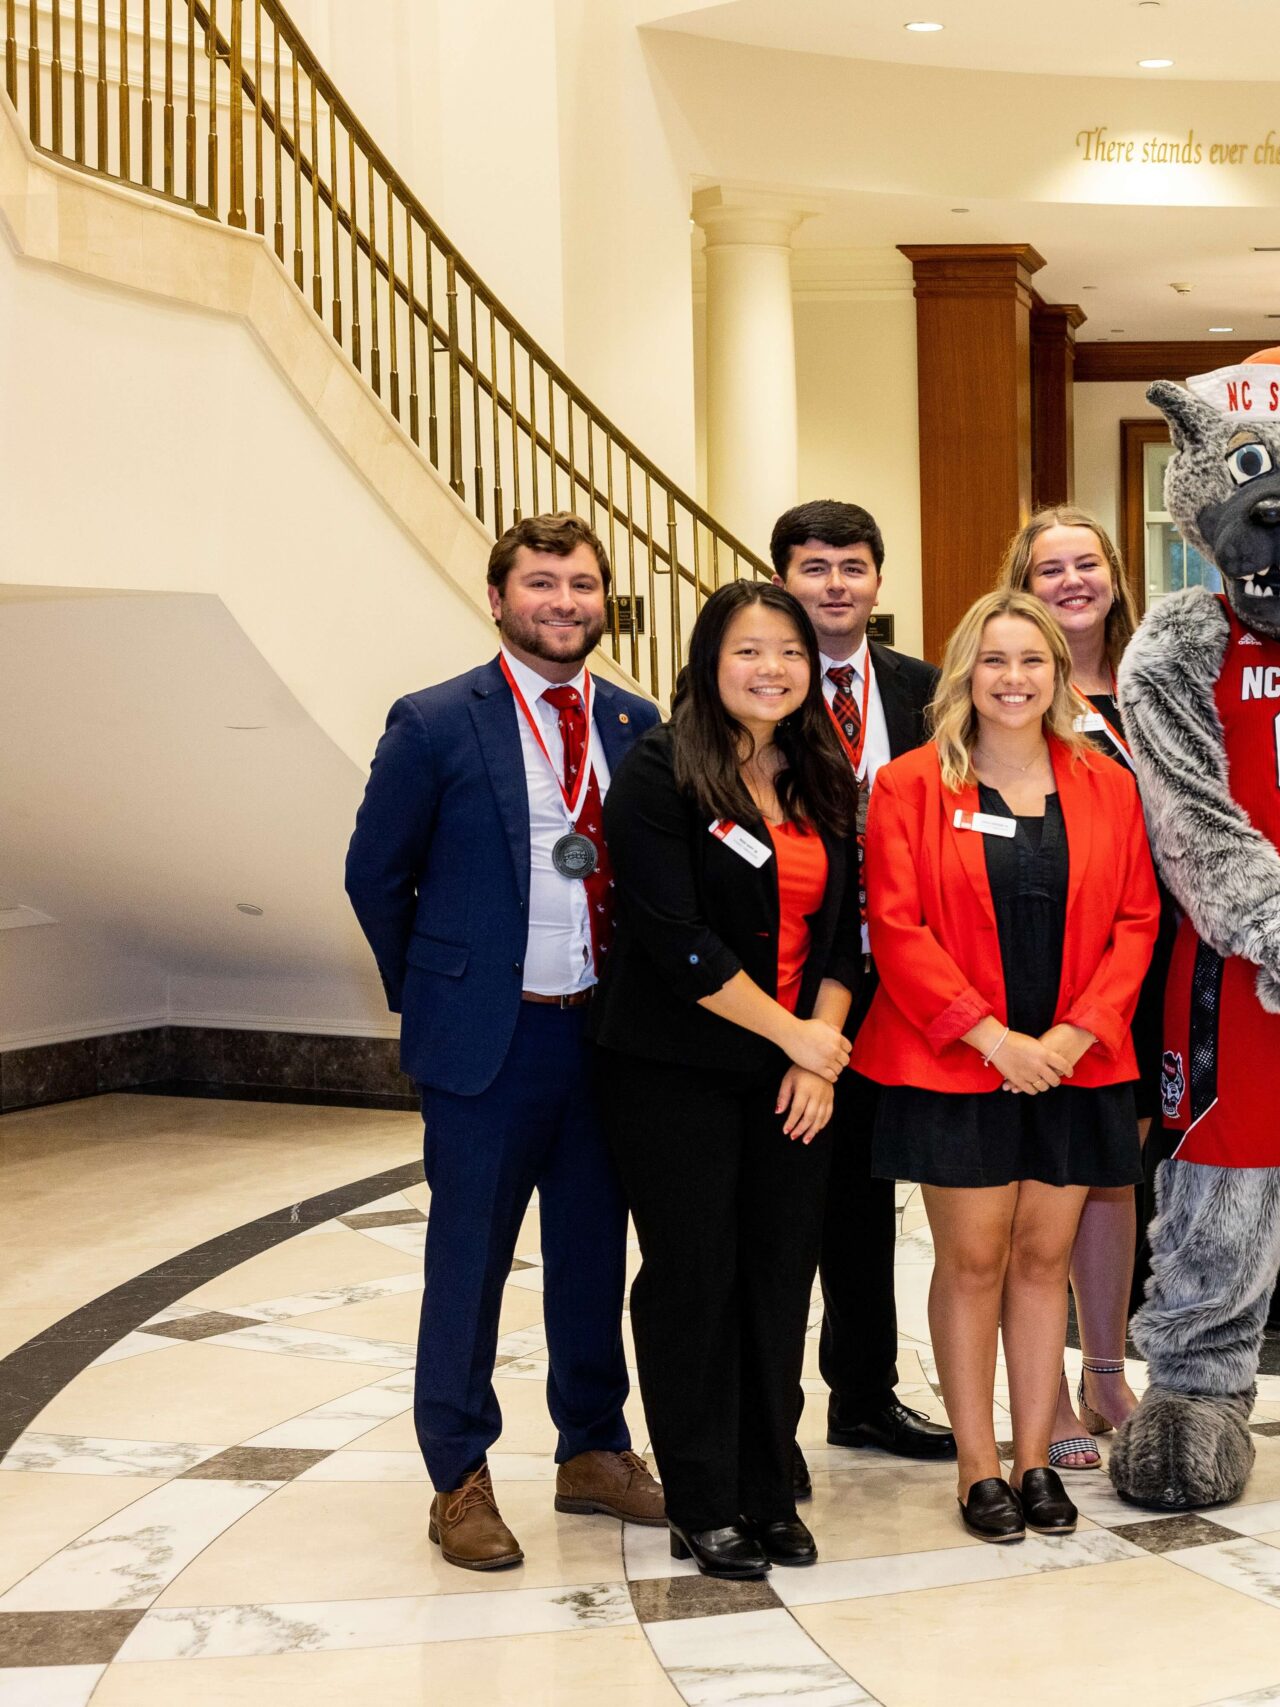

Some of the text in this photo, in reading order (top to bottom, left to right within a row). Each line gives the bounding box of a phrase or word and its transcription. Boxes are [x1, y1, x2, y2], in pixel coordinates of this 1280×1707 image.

[1076, 126, 1135, 162] There
[1141, 129, 1202, 164] stands
[1208, 142, 1249, 165] ever
[1226, 380, 1253, 412] NC
